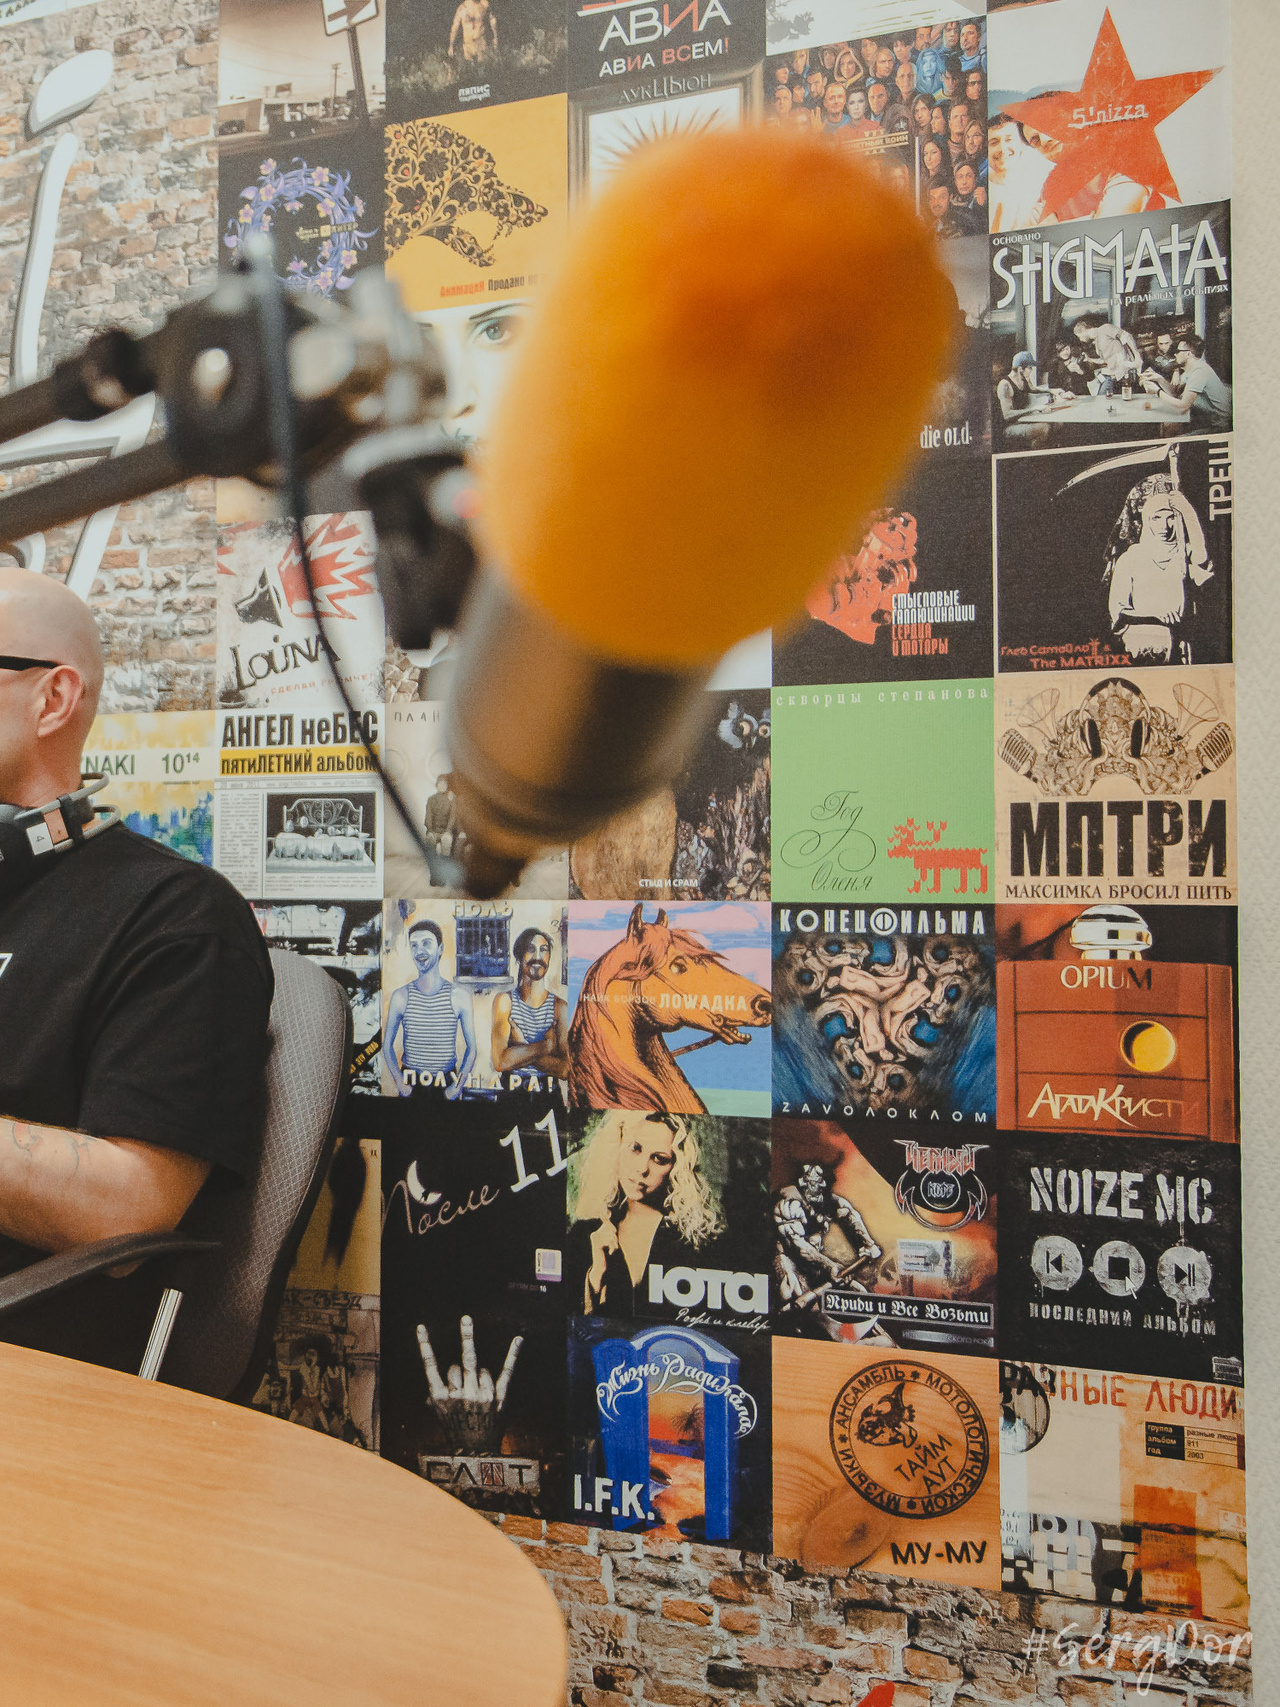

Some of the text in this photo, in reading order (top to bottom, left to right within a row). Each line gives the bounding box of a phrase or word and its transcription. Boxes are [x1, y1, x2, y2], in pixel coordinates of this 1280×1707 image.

[599, 0, 731, 51] АВИА
[599, 37, 729, 78] АВИА ВСЕМ!
[992, 232, 1041, 247] ОСНОВАНО
[892, 589, 960, 610] СМЫСЛОВЫЕ
[892, 604, 976, 625] ГАЛЛЮЦИНАЦИИ
[901, 638, 949, 656] МОТОРЫ
[1030, 654, 1131, 670] The MATRIXX
[776, 687, 988, 708] скворцы степанова
[222, 713, 294, 747] АНГЕЛ
[81, 754, 135, 775] NAKI
[1009, 800, 1227, 878] МПТРИ
[639, 878, 660, 890] СТЫД
[672, 878, 699, 888] СРАМ
[1004, 883, 1232, 901] МАКСИМКА БРОСИЛ ПИТЬ
[1059, 964, 1153, 992] OPIUM
[499, 1108, 568, 1194] 11
[1029, 1167, 1213, 1226] NOIZE MC
[1029, 1302, 1217, 1338] ПОСЛЕДНИЙ АЛЬБОМ
[835, 1365, 906, 1430] АНСАМБЛЬ
[1145, 1379, 1237, 1422] ЛЮДИ
[1147, 1424, 1173, 1434] группа
[1147, 1435, 1177, 1445] альбом
[1186, 1429, 1215, 1440] разные
[1186, 1450, 1205, 1460] 2003
[1187, 1439, 1199, 1448] 911
[894, 1434, 953, 1482] ТАЙМ
[838, 1448, 901, 1511] МУЗЫКИ
[922, 1456, 958, 1494] АУТ
[573, 1473, 655, 1522] I.F.K.
[890, 1540, 987, 1565] МУ-МУ
